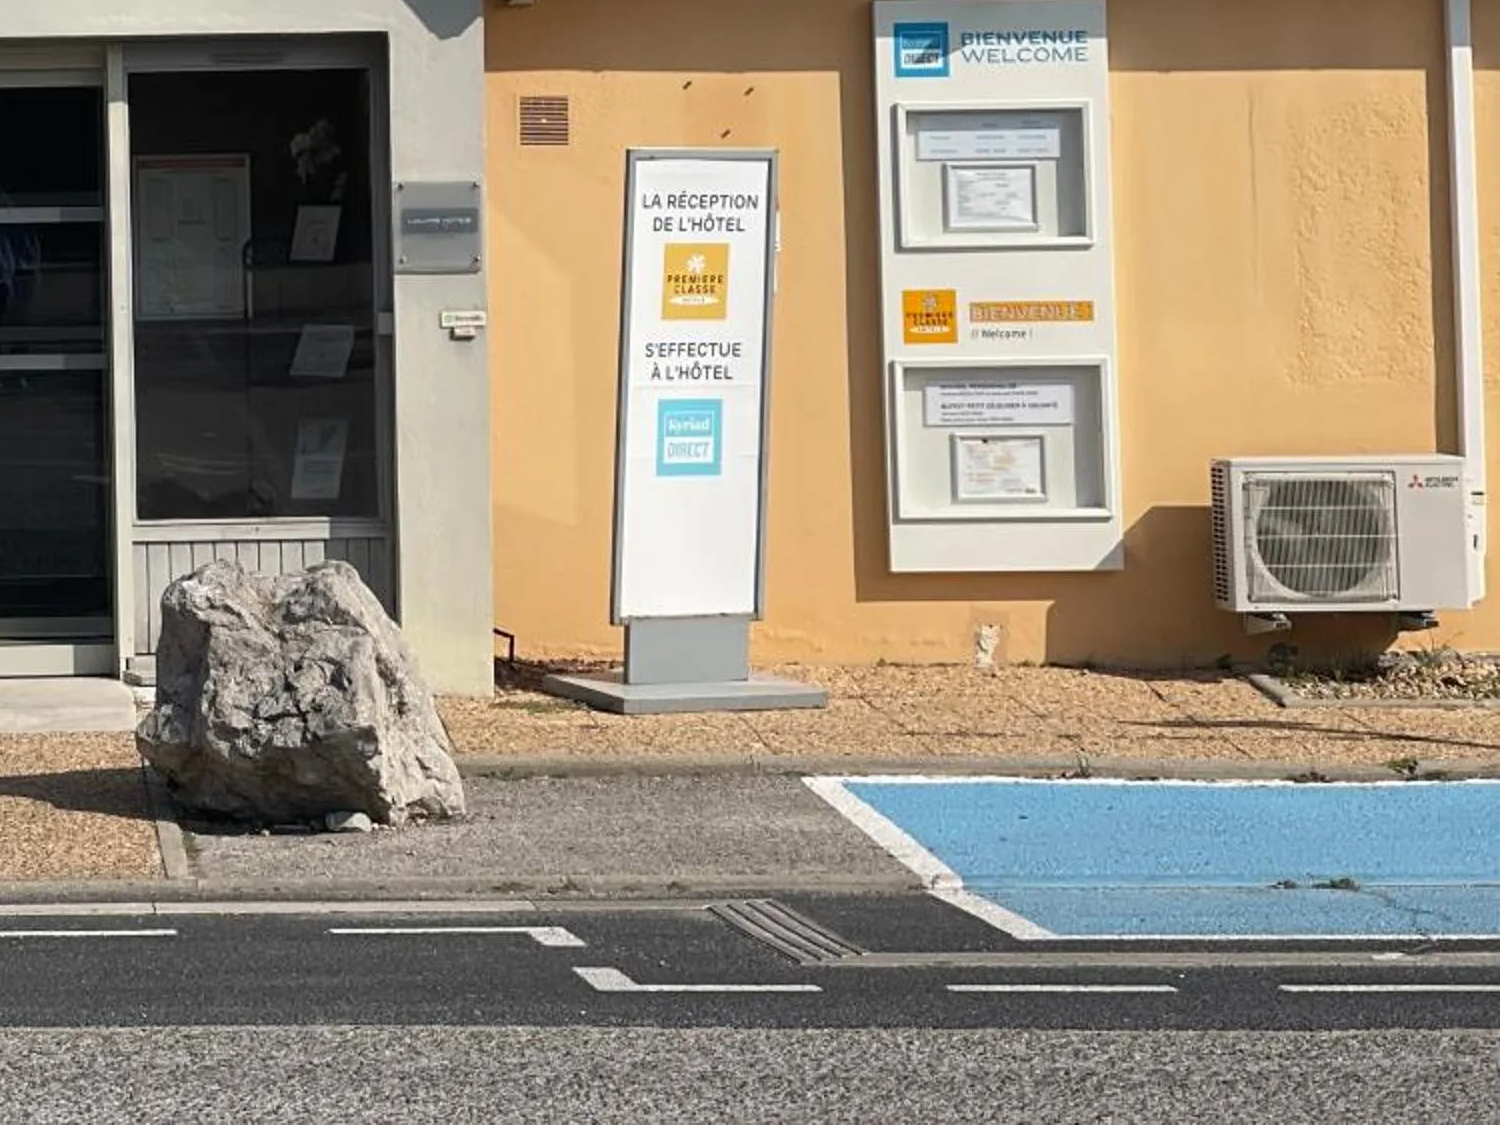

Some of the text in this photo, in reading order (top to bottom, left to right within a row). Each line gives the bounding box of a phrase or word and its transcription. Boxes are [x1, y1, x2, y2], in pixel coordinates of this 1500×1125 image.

[961, 30, 1088, 46] BIENVENUE
[961, 46, 1088, 63] WELCOME
[643, 190, 759, 209] LA RÉCEPTION
[653, 212, 746, 232] DE L'HÔTEL
[674, 284, 716, 294] CLASSE
[645, 342, 741, 358] S'EFFECTUE
[651, 360, 733, 380] À L'HÔTEL
[667, 442, 710, 458] DIRECT
